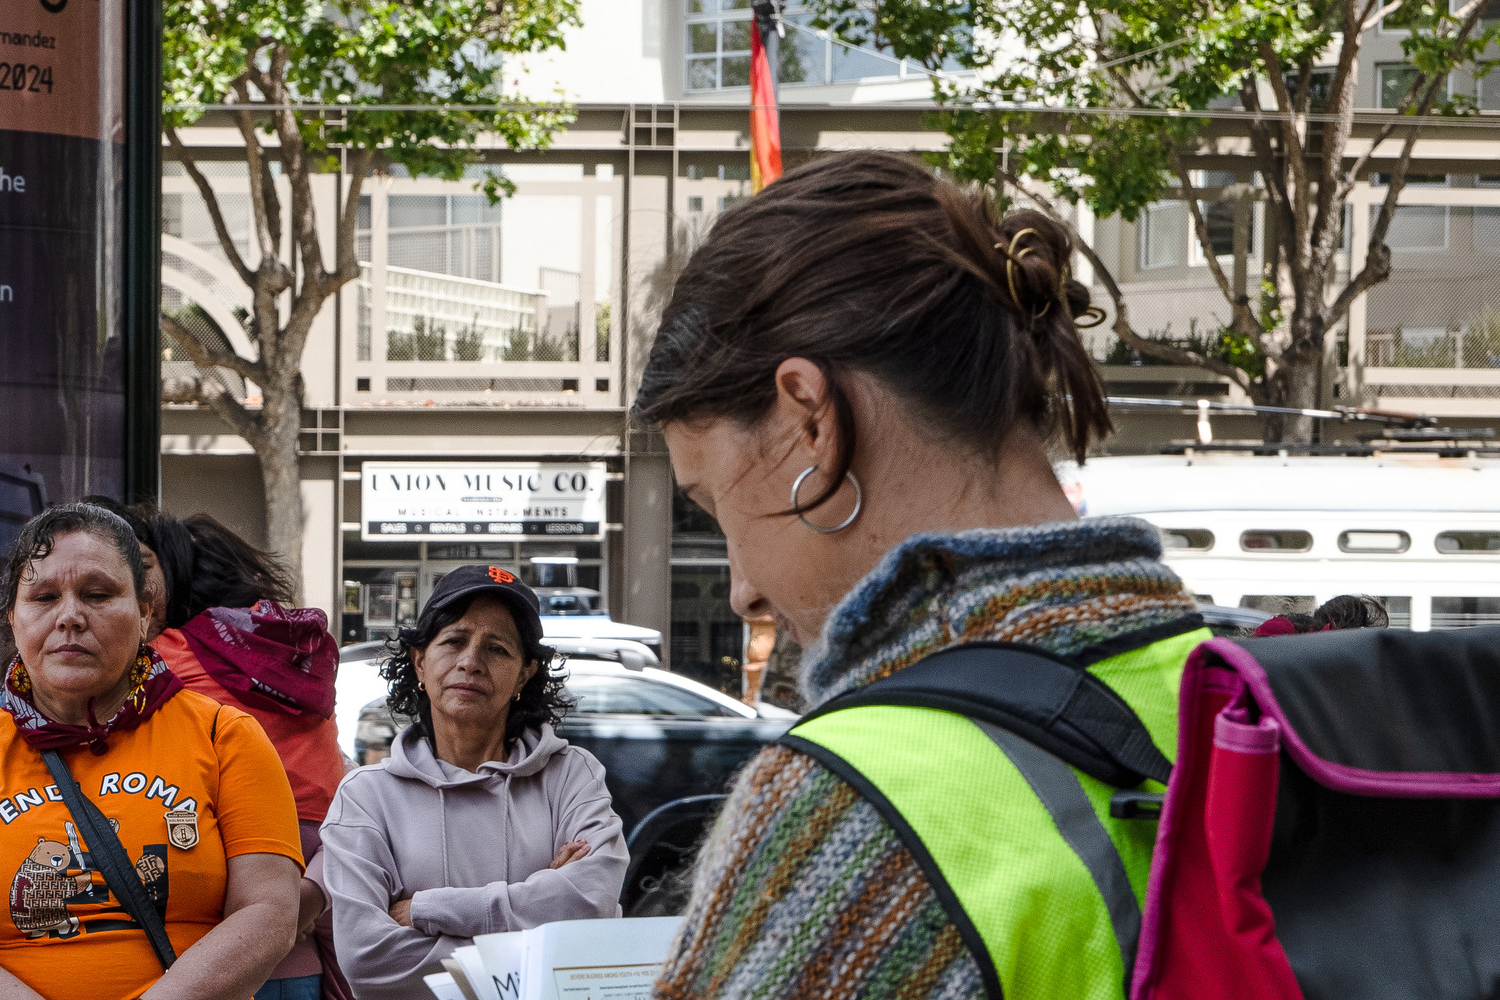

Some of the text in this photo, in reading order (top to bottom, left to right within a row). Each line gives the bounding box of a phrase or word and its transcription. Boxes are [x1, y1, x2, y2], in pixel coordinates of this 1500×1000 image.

[371, 471, 594, 492] UNION MUSIC CO.
[381, 522, 408, 534] SALES
[430, 522, 467, 534] RENTALS
[546, 522, 585, 534] LESSONS
[100, 772, 198, 815] ROMA
